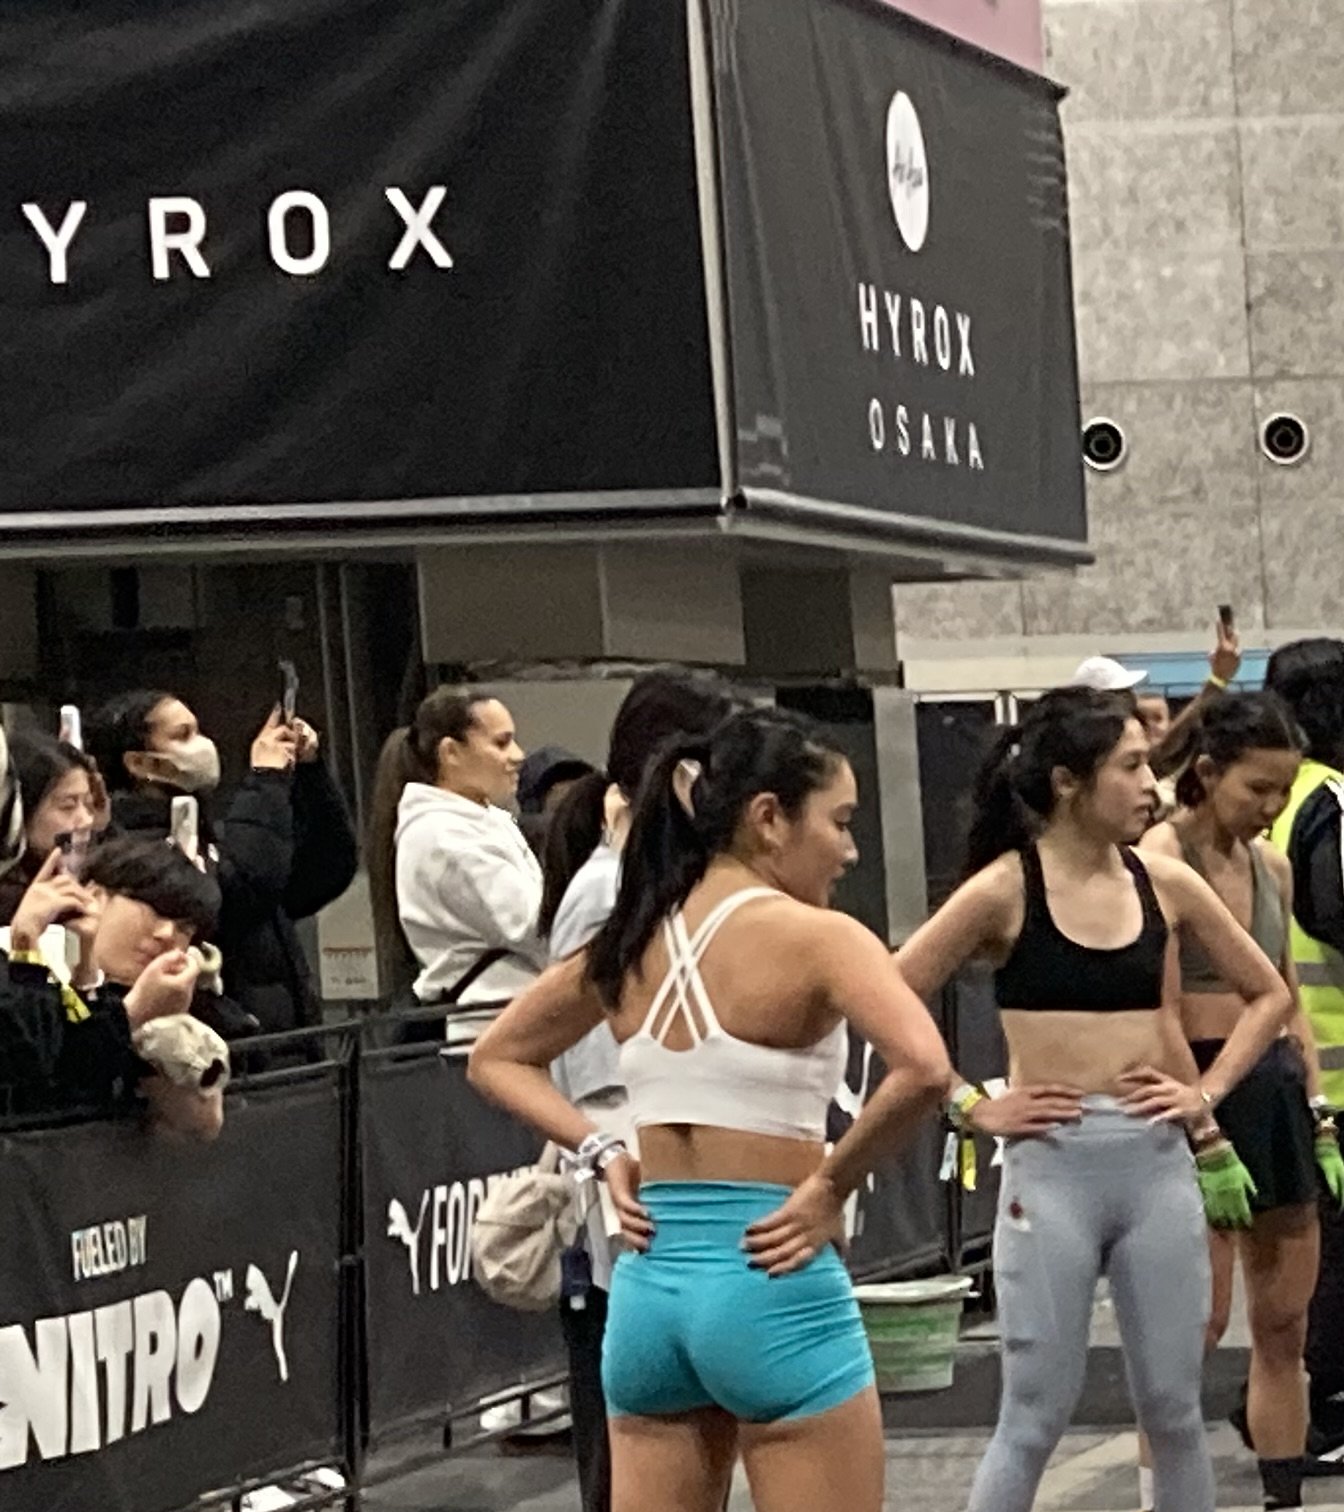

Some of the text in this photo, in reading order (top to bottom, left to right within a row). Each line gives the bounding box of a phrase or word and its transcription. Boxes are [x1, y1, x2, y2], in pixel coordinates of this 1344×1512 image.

[858, 282, 976, 377] HYROX
[868, 397, 985, 471] OSAKA
[71, 1214, 148, 1282] FUELED BY
